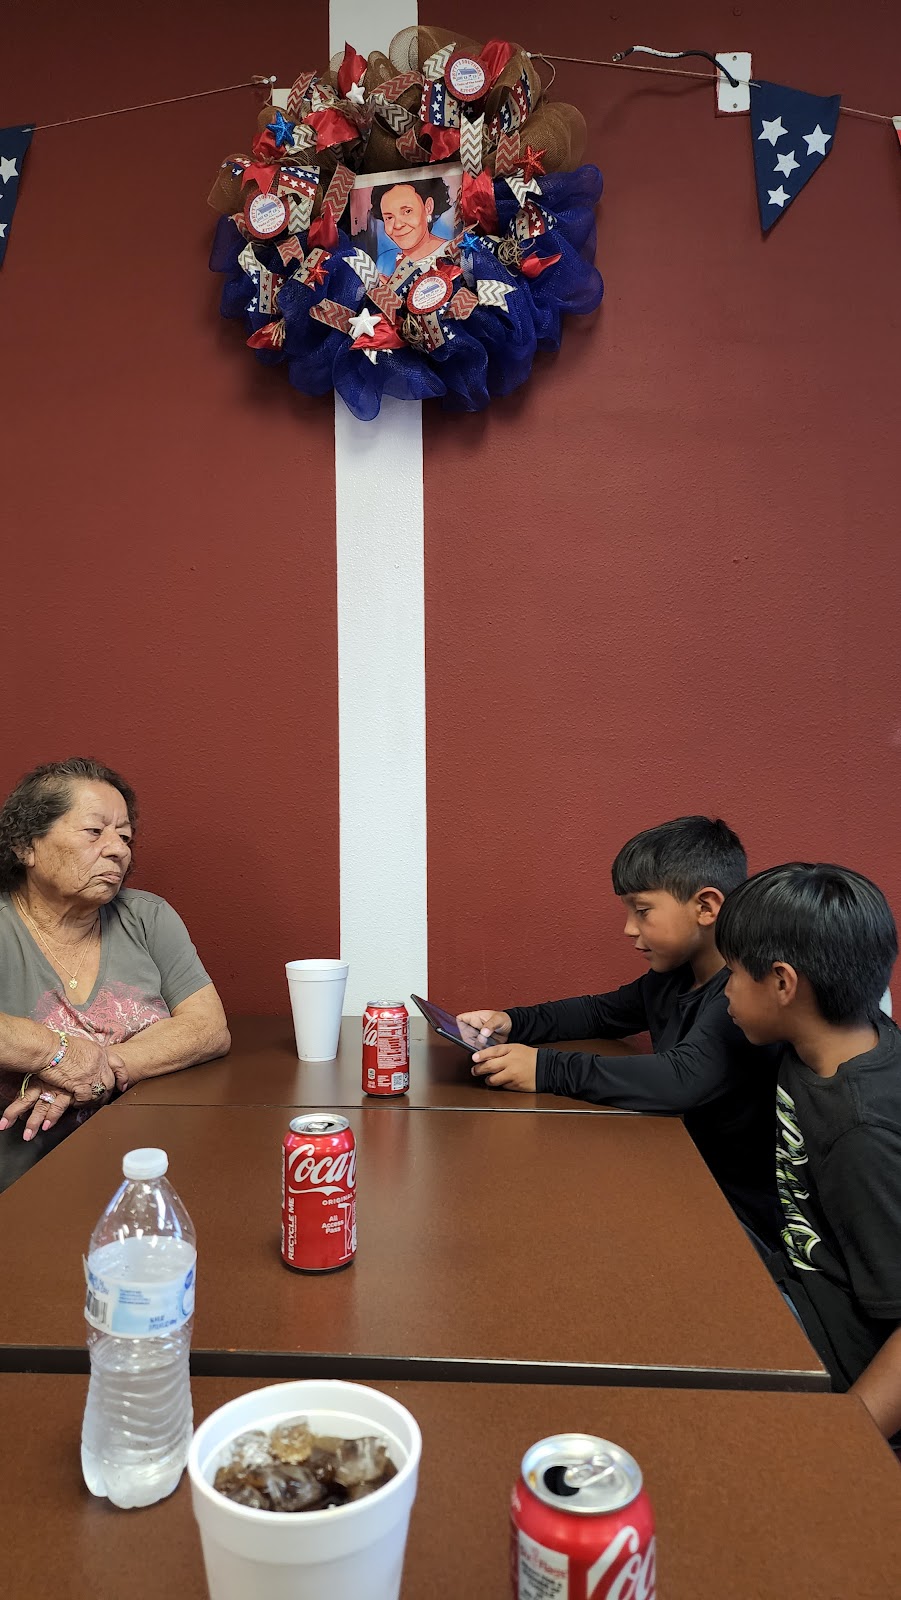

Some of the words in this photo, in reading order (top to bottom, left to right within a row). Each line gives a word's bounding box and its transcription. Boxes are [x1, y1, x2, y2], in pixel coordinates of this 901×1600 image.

[258, 195, 282, 208] SOTHERN
[288, 1196, 295, 1213] ME
[322, 1193, 354, 1206] ORIGINAL
[321, 1220, 344, 1229] Access
[328, 1214, 339, 1222] All
